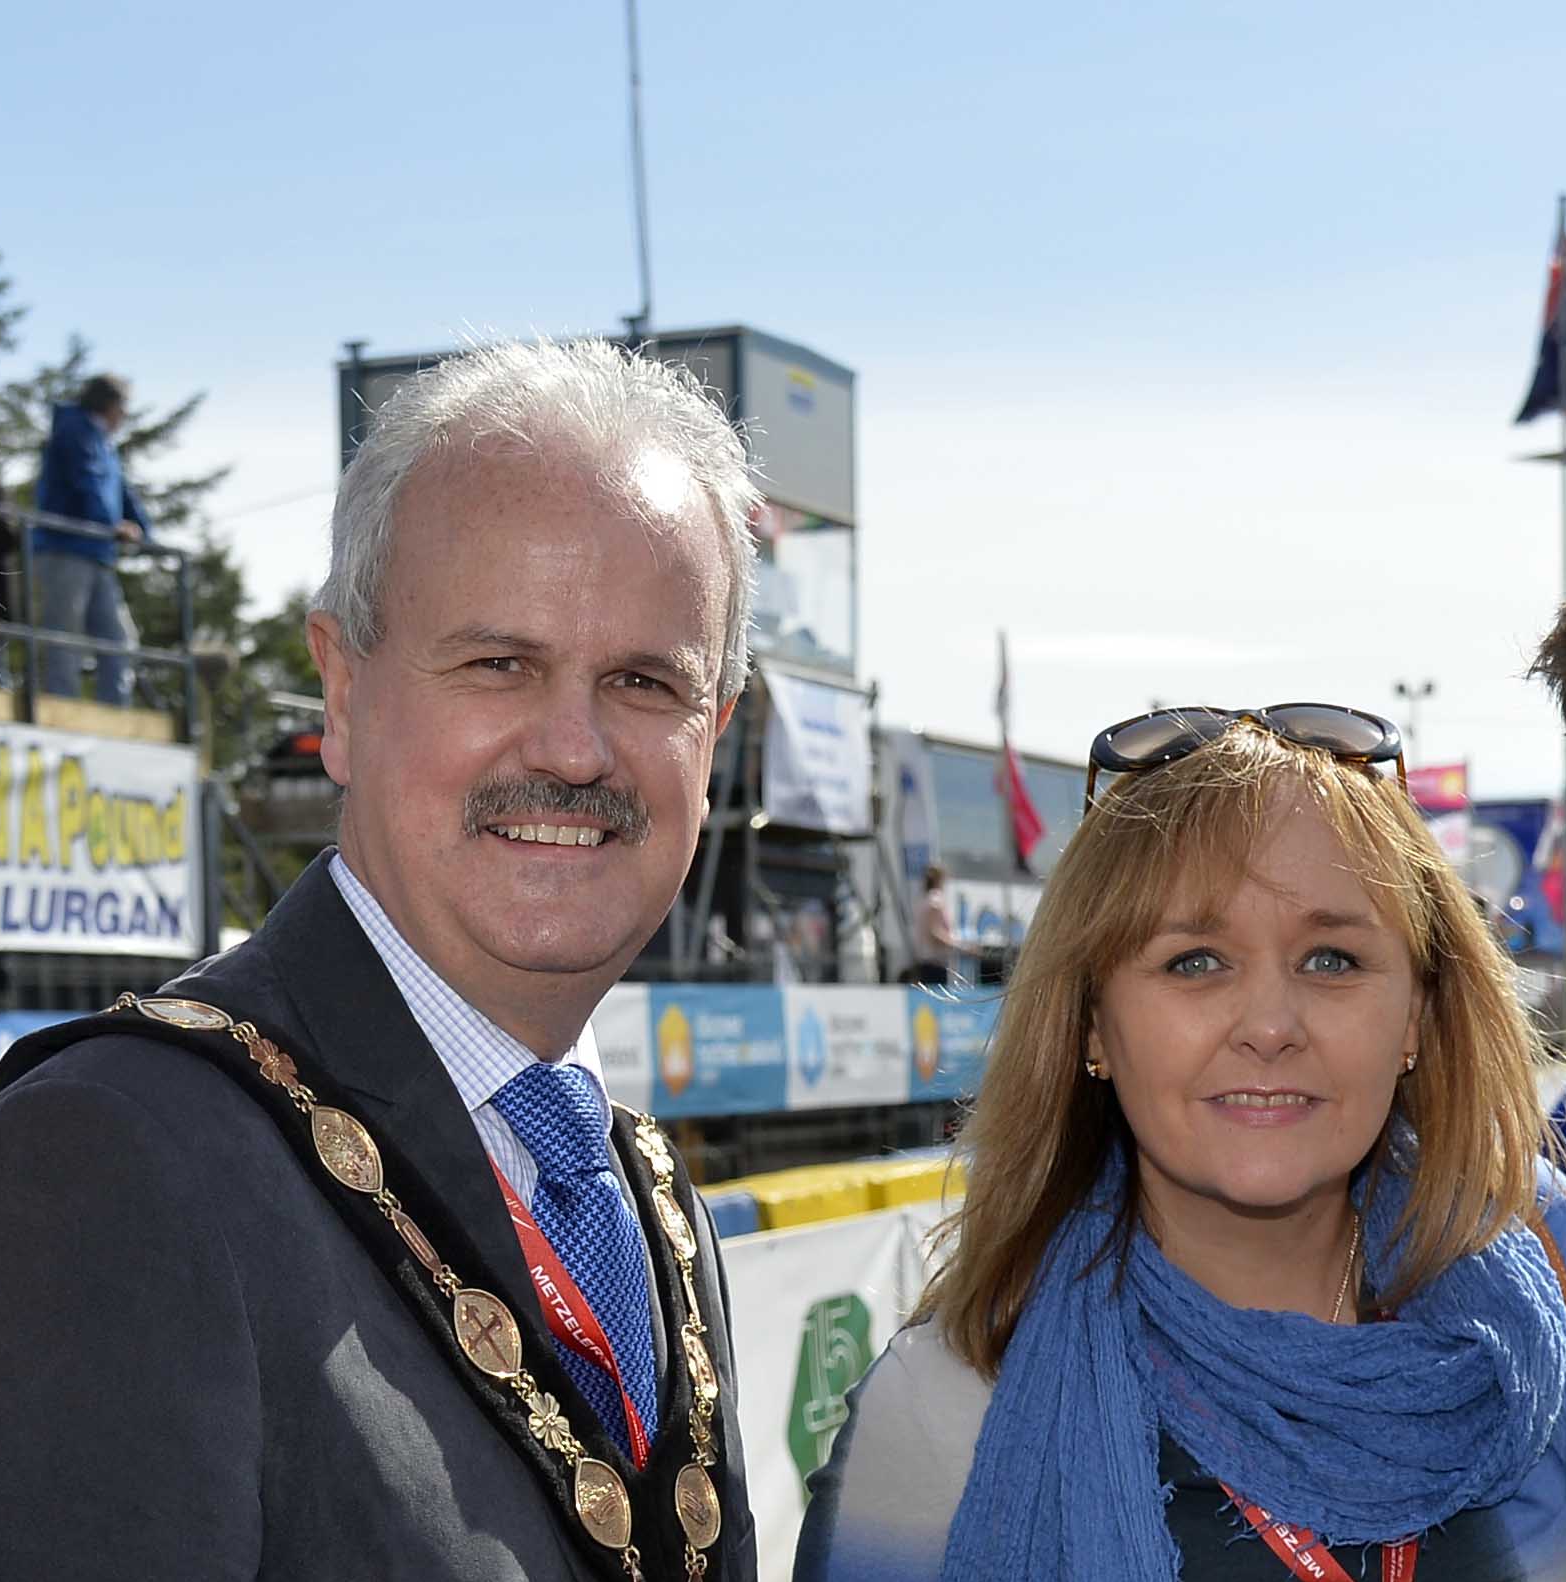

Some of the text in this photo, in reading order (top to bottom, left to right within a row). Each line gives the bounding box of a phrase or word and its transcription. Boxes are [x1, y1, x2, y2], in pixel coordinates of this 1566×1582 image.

[19, 746, 52, 870] A
[58, 755, 186, 872] Pound
[1, 885, 182, 937] LURGAN
[531, 1264, 604, 1361] METZELER
